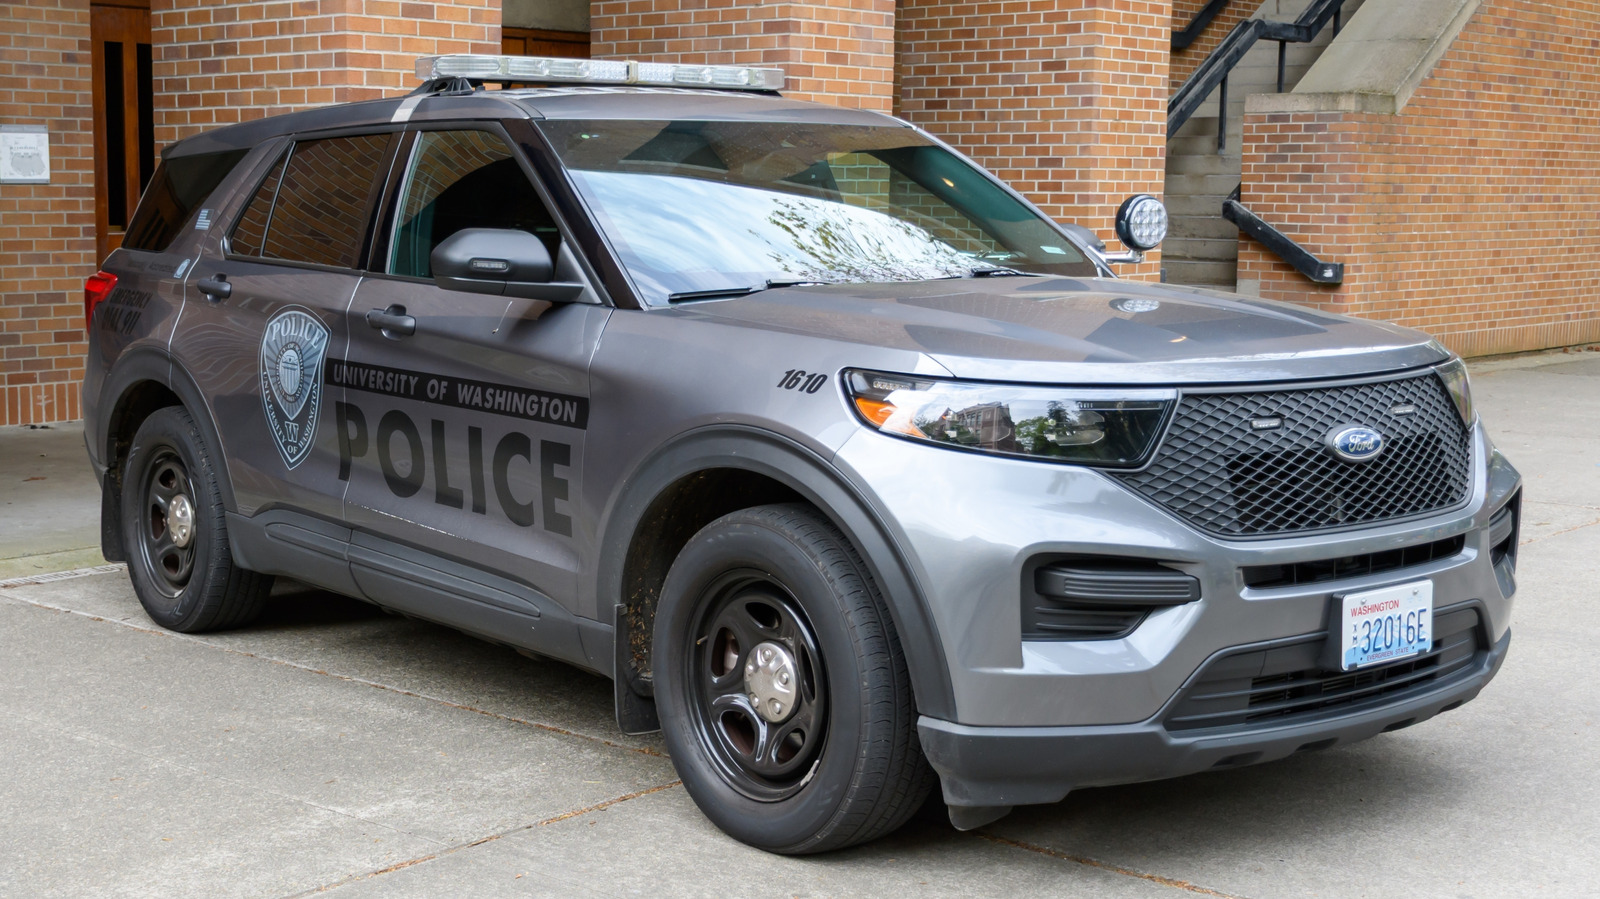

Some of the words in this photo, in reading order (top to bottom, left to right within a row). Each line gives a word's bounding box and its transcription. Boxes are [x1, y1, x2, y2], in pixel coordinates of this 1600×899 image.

[121, 310, 142, 335] 911
[271, 317, 324, 349] POLICE
[333, 363, 419, 396] UNIVERSITY
[426, 378, 448, 401] OF
[457, 383, 578, 423] WASHINGTON
[776, 369, 828, 394] 1610
[263, 371, 288, 443] UNIVERSITY
[287, 445, 298, 455] OF
[298, 383, 317, 448] WASHINGTON
[284, 421, 299, 443] W
[1348, 434, 1375, 453] Ford
[335, 400, 573, 538] POLICE
[1350, 599, 1400, 618] WASHINGTON
[1361, 608, 1427, 655] 32016E
[1366, 649, 1394, 662] EVERGREEN
[1395, 646, 1409, 656] STATE
